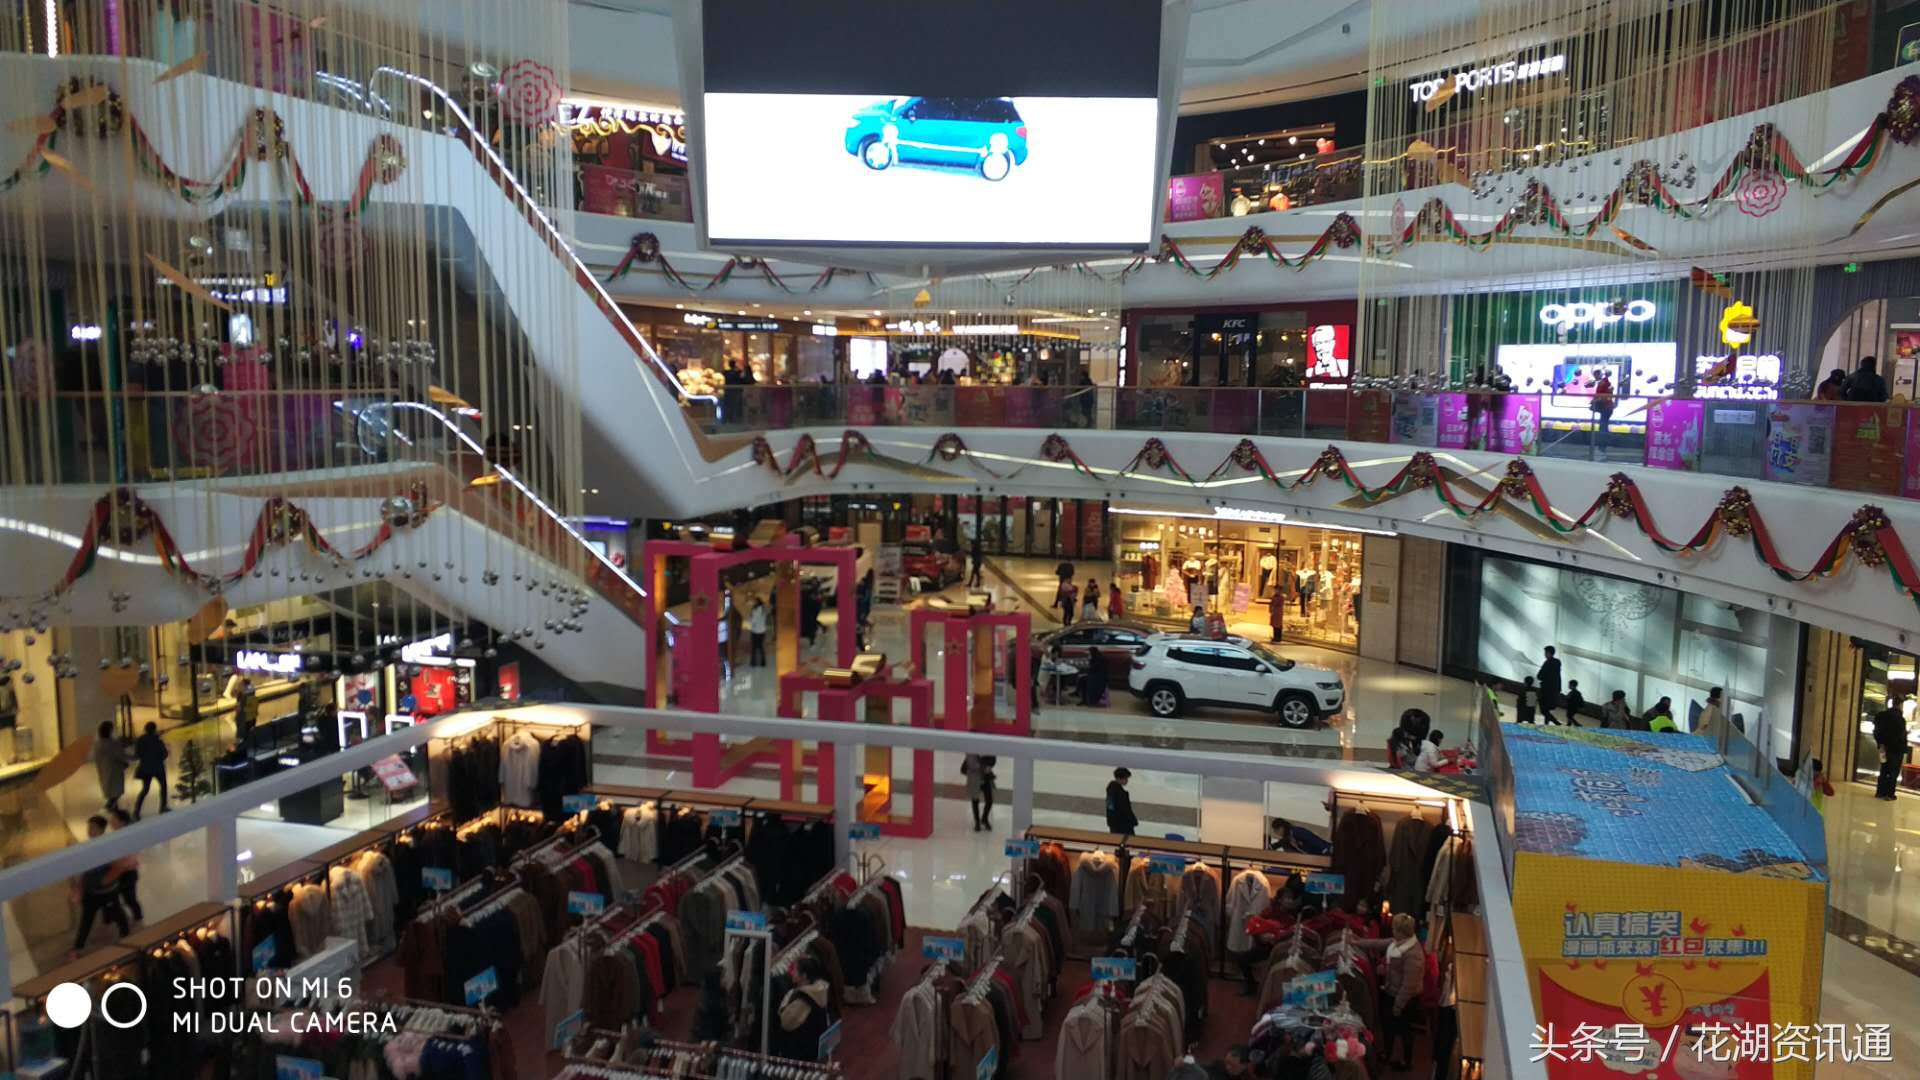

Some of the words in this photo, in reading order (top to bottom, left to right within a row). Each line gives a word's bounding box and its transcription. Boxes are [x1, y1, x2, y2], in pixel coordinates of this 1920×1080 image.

[1409, 61, 1516, 103] TOPPORTS
[1222, 319, 1246, 329] KFC
[1564, 911, 1681, 937] 认真搞笑
